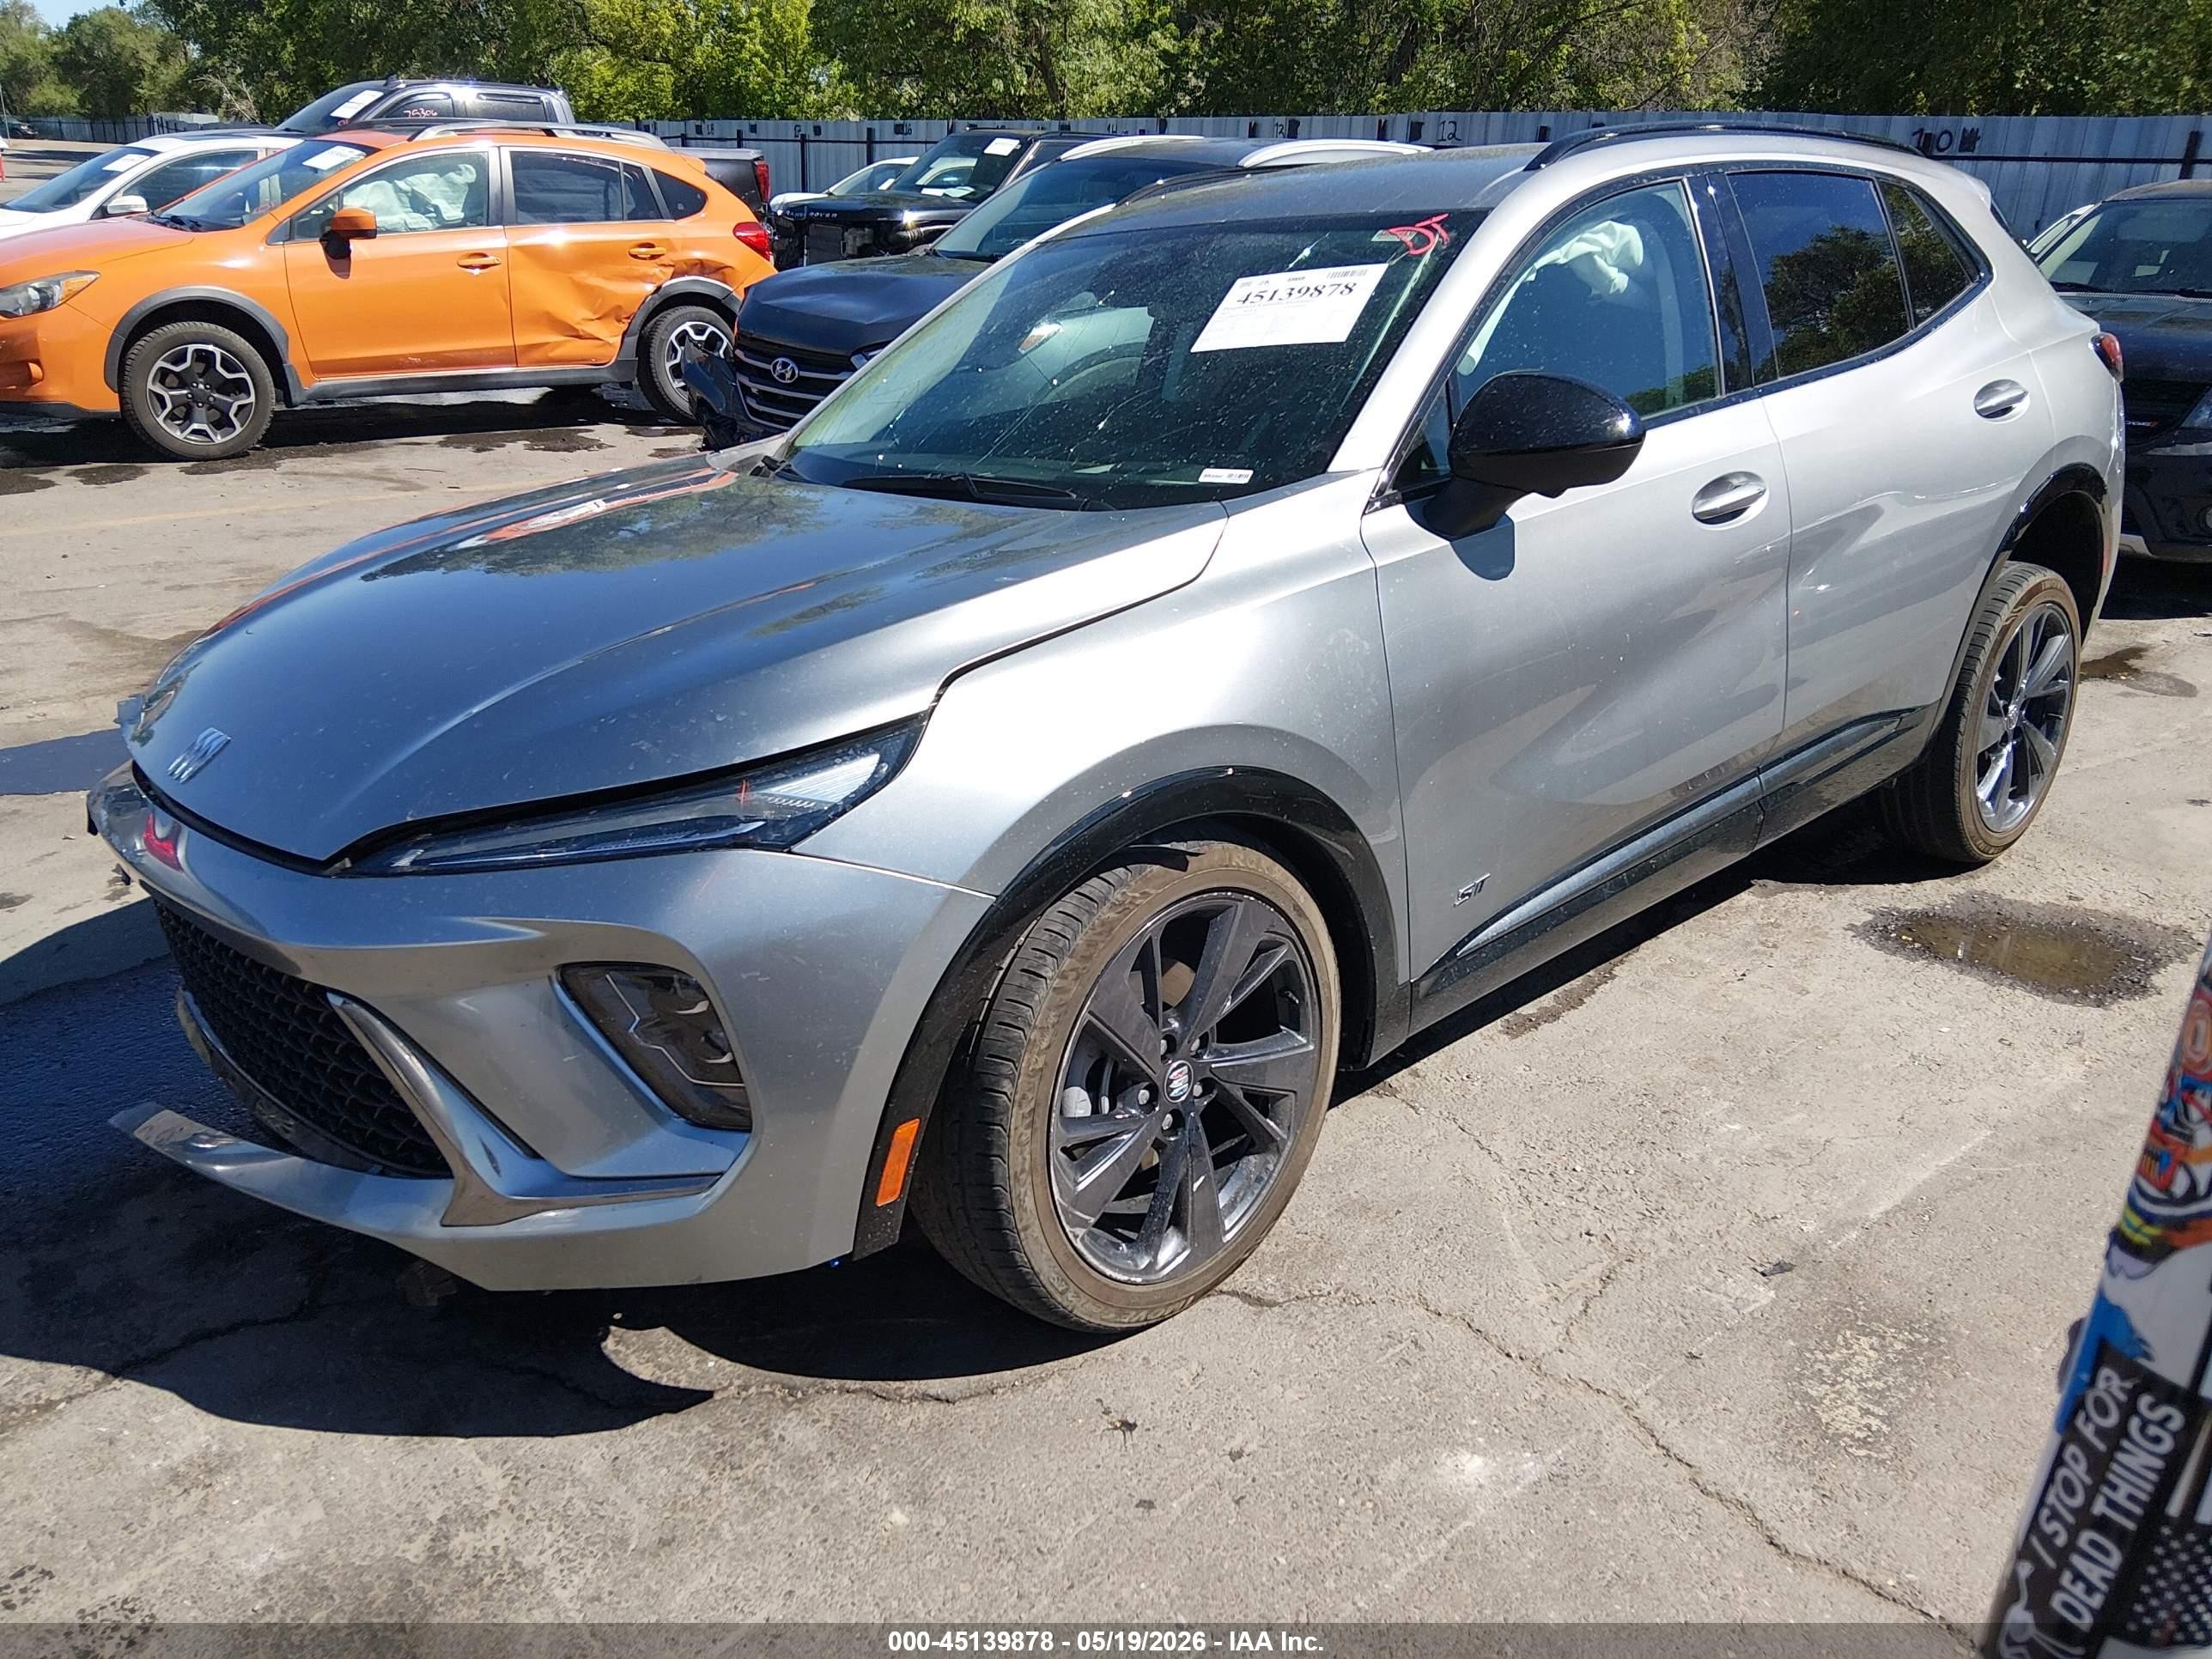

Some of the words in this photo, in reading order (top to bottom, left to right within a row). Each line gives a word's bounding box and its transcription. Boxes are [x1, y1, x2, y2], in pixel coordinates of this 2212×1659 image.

[1437, 120, 1462, 142] 12
[1236, 282, 1358, 306] 45139878
[1453, 872, 1491, 908] ST
[2038, 1442, 2094, 1548] STOP
[2074, 1365, 2131, 1453] FOR
[2048, 1528, 2124, 1632] DEAD
[2089, 1391, 2186, 1532] THINGS
